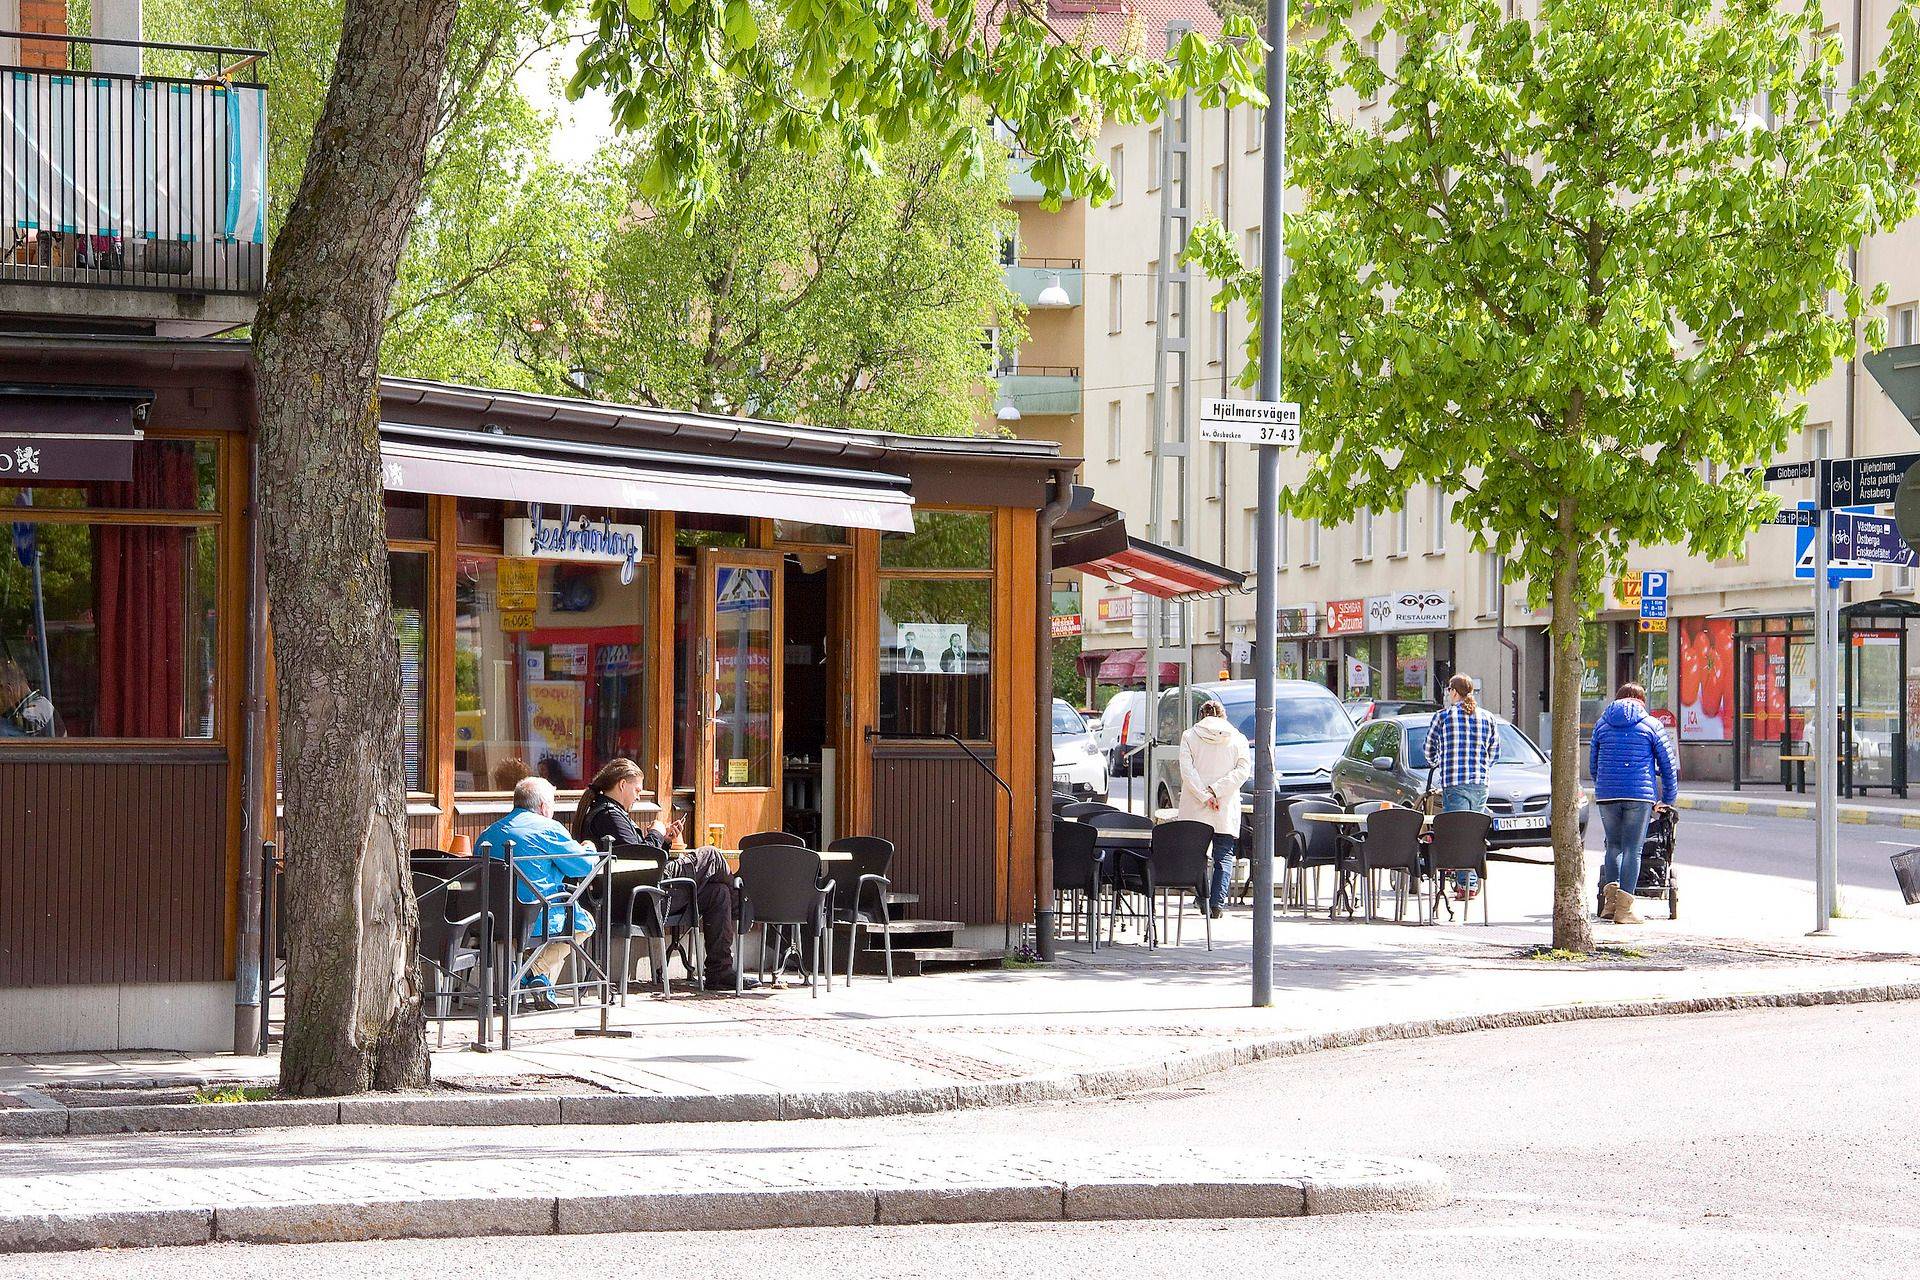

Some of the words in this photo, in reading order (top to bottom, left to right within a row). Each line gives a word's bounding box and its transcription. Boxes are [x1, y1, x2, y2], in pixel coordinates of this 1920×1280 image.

[1213, 403, 1296, 422] Hjälmarsvägen
[1260, 427, 1295, 441] 37-43
[1777, 466, 1799, 479] Globen
[1859, 461, 1896, 475] Liljeholmen
[1859, 474, 1877, 487] Årsta
[1859, 486, 1891, 499] Årstaberg
[1857, 521, 1883, 535] Västberga
[1856, 532, 1880, 547] Östberga
[1648, 573, 1664, 596] P
[1687, 711, 1698, 725] ICA
[1500, 819, 1518, 829] UNT
[1525, 818, 1545, 828] 310
